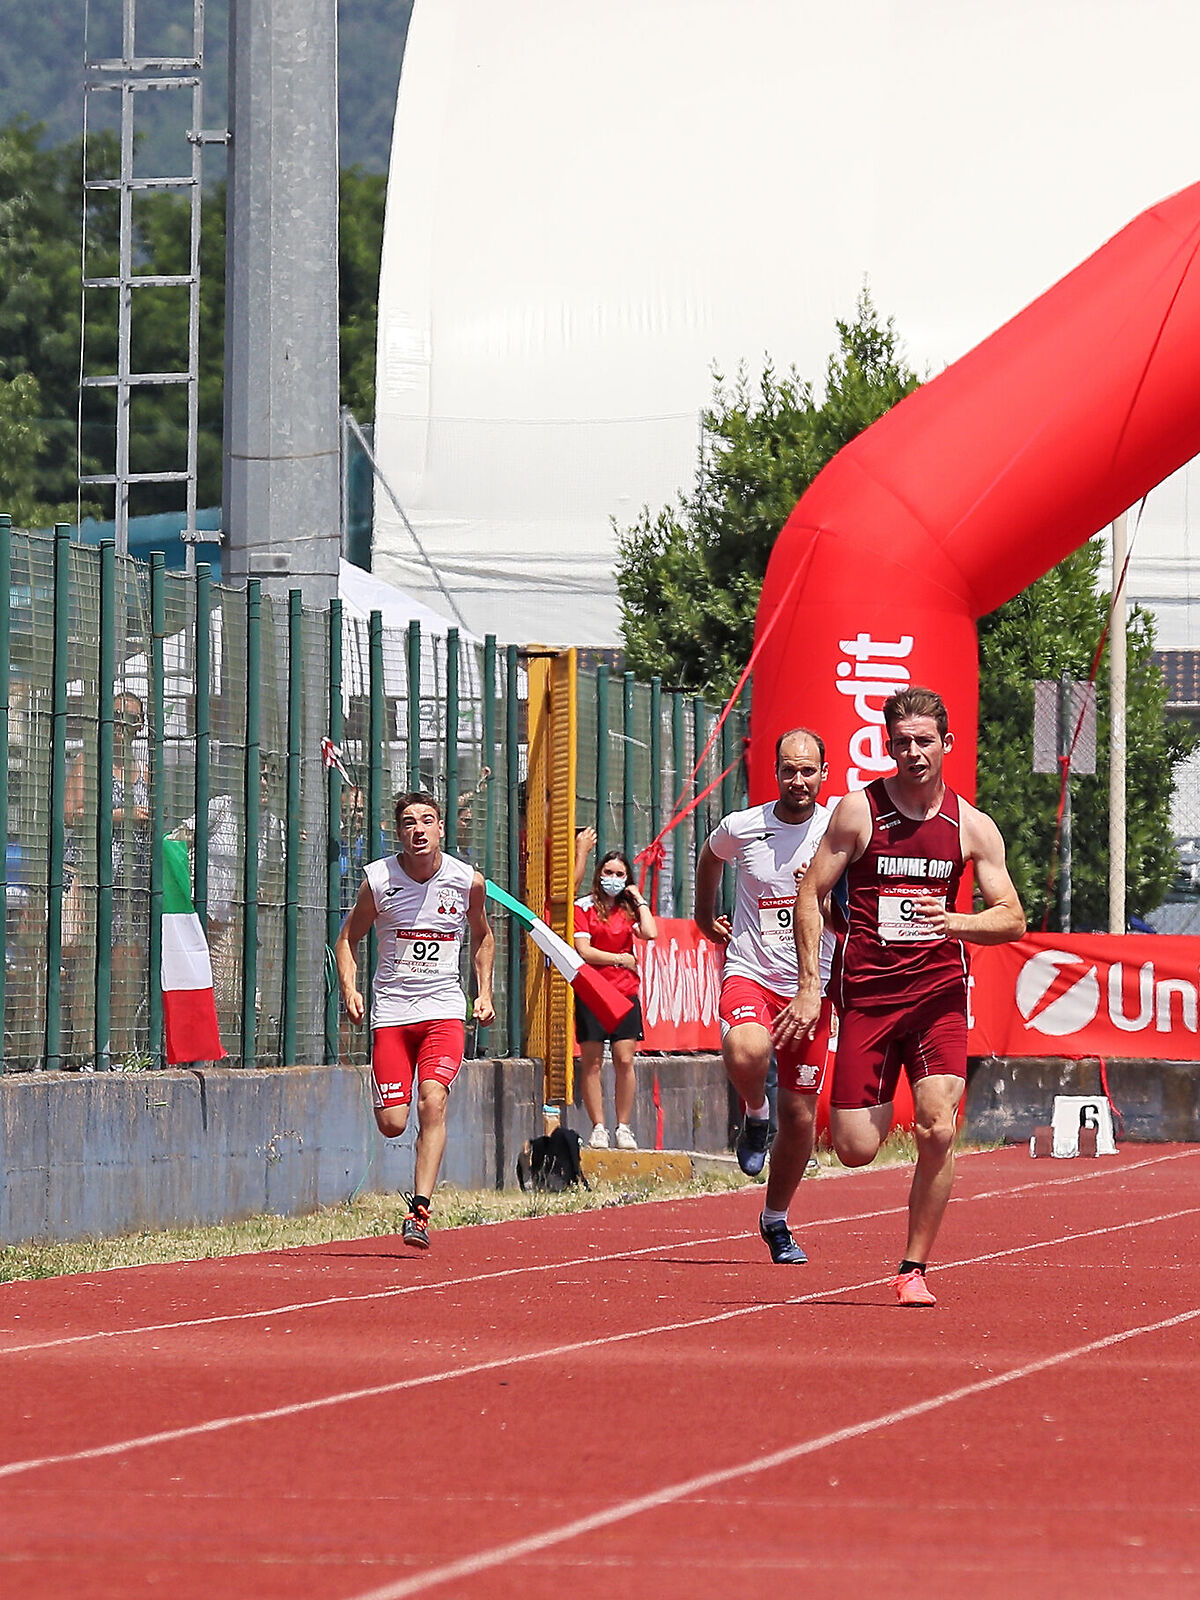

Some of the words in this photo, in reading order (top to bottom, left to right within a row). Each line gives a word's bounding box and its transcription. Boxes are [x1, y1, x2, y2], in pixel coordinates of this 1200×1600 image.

[833, 633, 914, 797] redit
[877, 856, 927, 877] FIAMME
[928, 859, 953, 879] ORO
[413, 941, 440, 962] 92
[1079, 1104, 1099, 1130] 6
